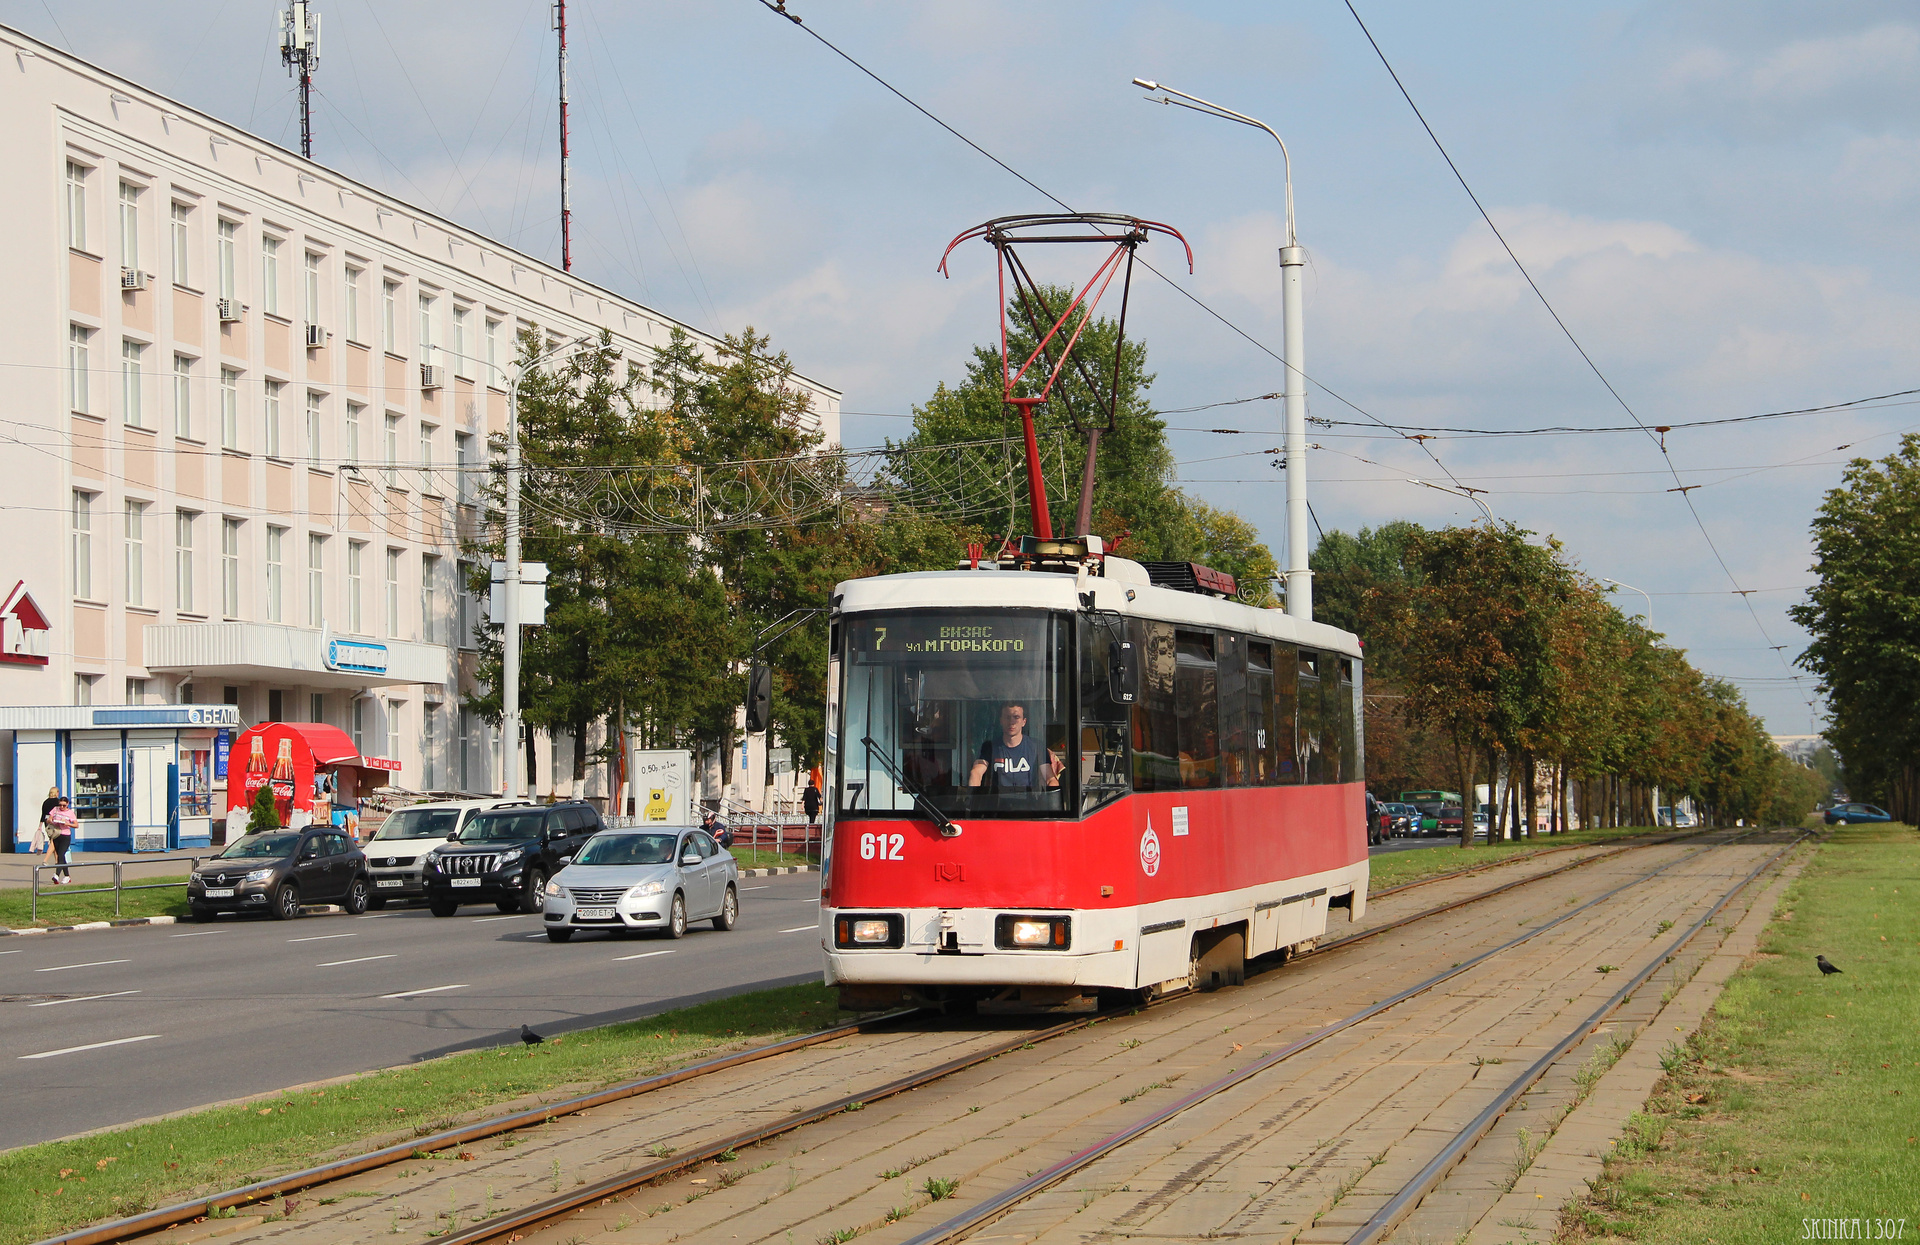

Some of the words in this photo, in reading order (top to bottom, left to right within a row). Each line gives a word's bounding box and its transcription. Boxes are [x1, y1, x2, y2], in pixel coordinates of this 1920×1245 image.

[875, 627, 887, 651] 7
[940, 626, 993, 638] ВИЗАС
[1122, 693, 1133, 701] 612
[1257, 728, 1267, 749] 612
[993, 757, 1031, 773] FILA
[846, 783, 865, 813] 7
[860, 832, 905, 861] 612
[582, 909, 598, 917] 2090
[598, 909, 615, 917] ET-2
